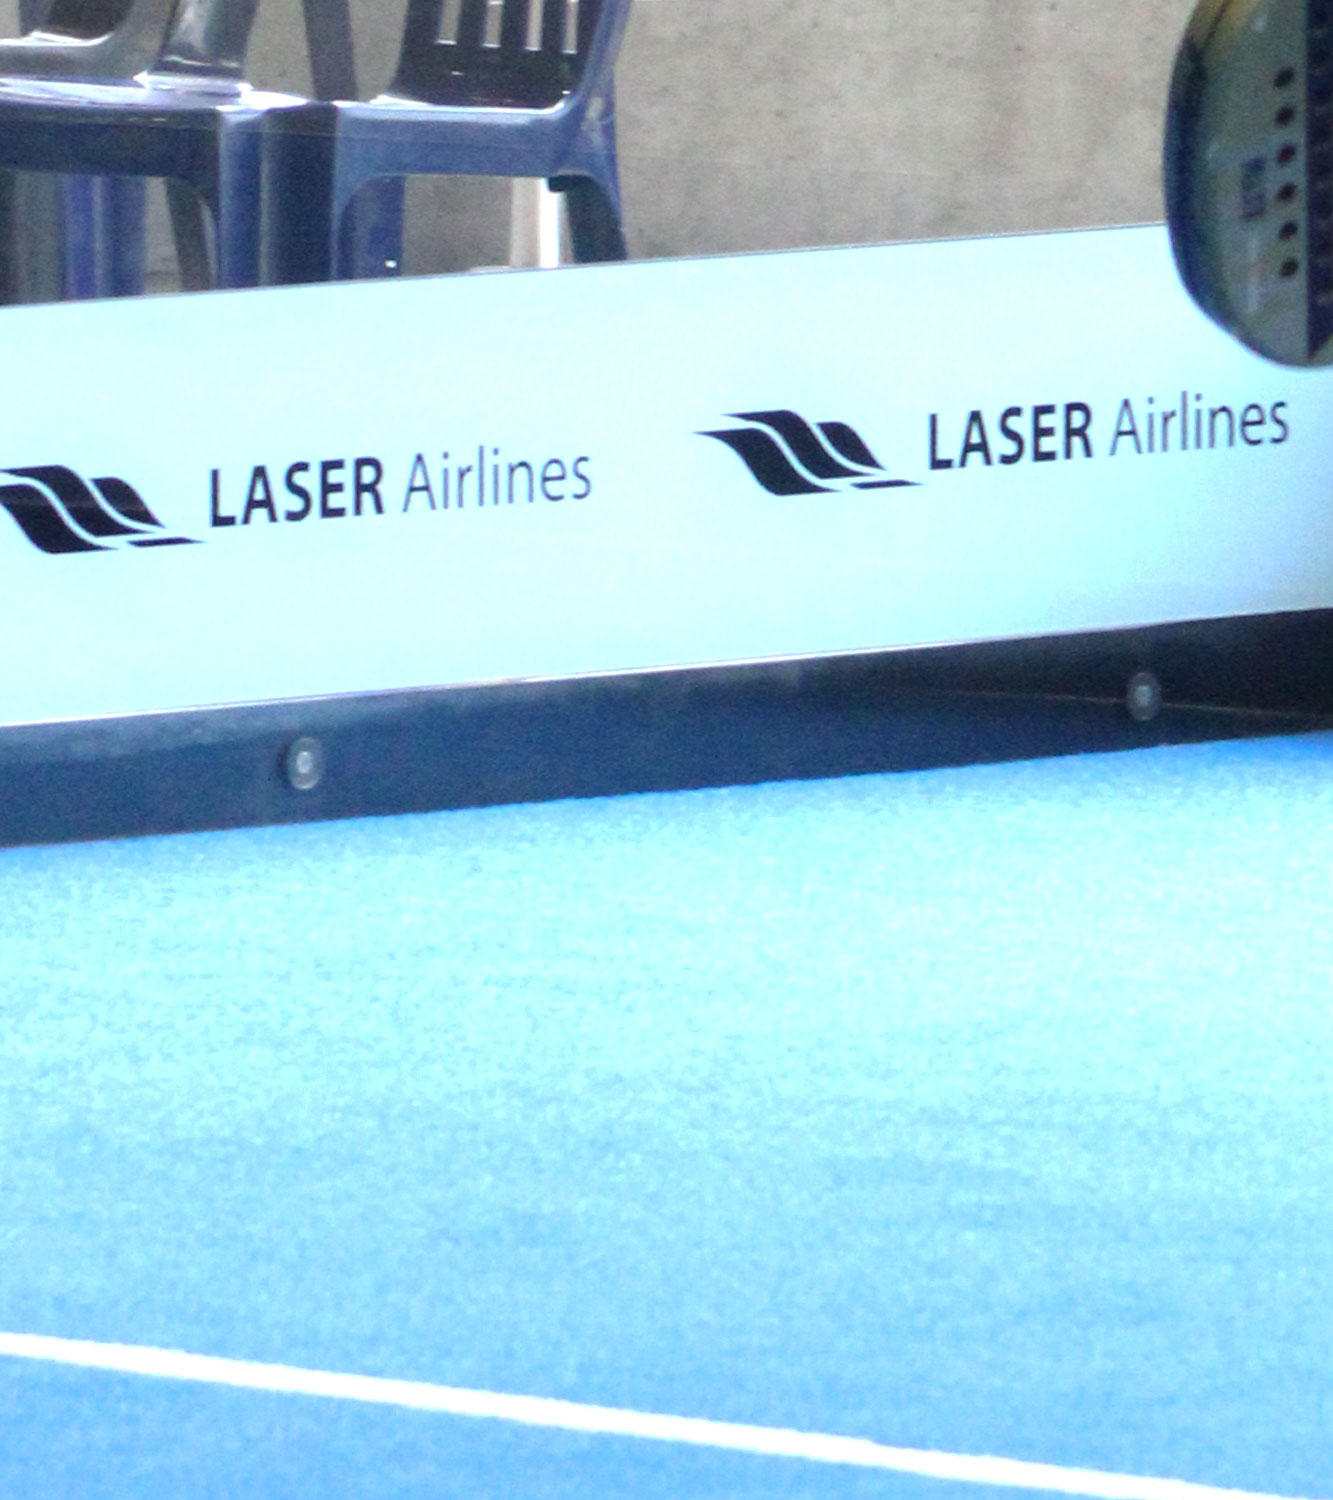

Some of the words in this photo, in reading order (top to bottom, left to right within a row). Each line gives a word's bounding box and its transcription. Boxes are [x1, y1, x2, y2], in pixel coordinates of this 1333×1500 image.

[930, 402, 1093, 471] LASER
[1110, 391, 1290, 456] Airlines
[210, 457, 385, 527] LASER
[402, 446, 592, 512] Airlines
